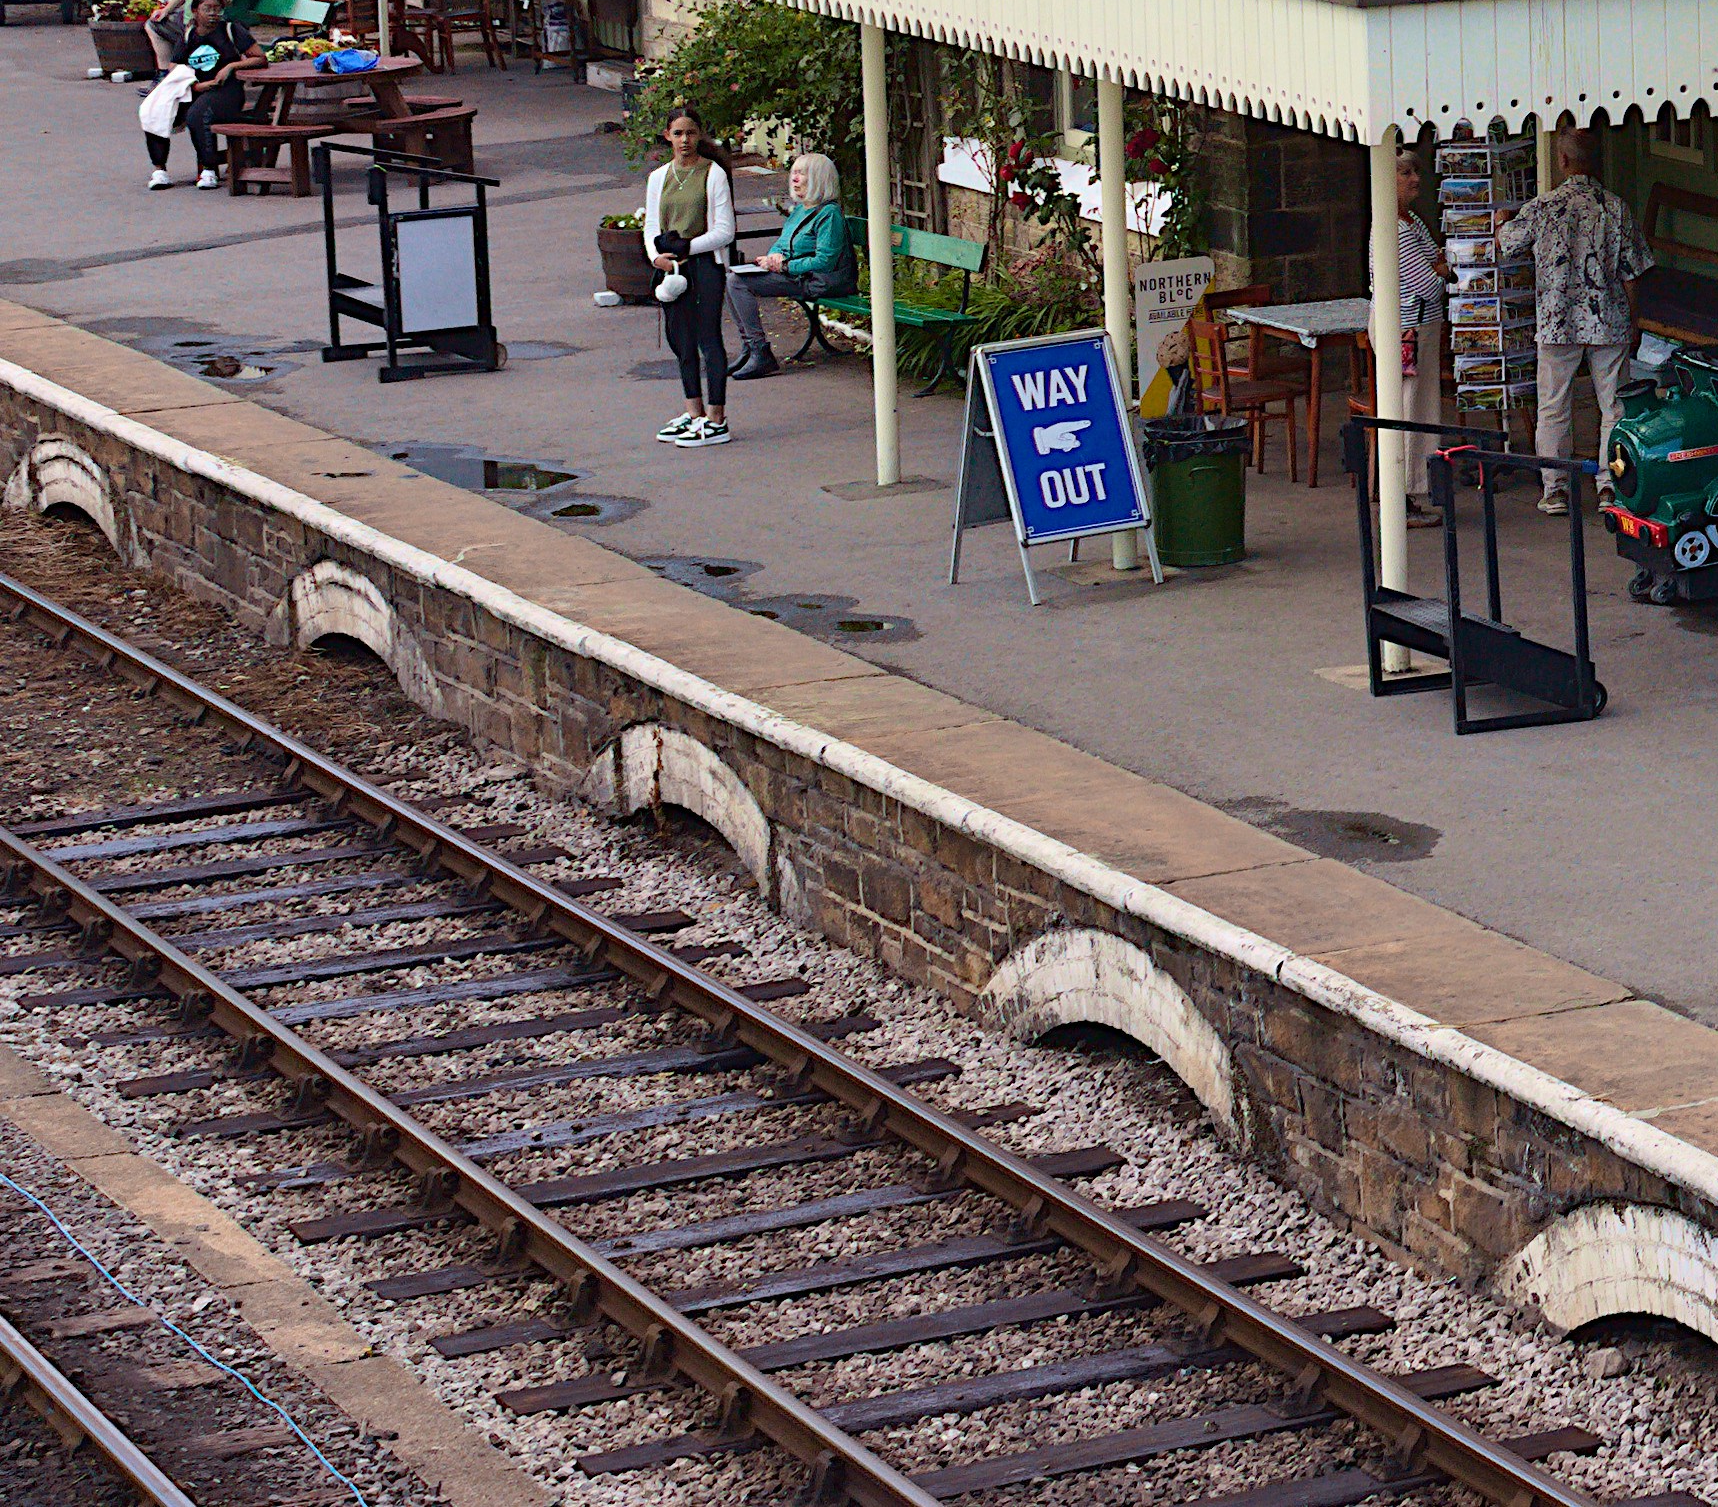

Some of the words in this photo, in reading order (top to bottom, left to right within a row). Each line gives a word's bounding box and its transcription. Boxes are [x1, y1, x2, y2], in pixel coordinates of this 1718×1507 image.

[1139, 272, 1211, 292] NORTHERN
[1148, 308, 1185, 321] AVAILABLE
[1010, 364, 1088, 411] WAY
[1039, 462, 1107, 509] OUT
